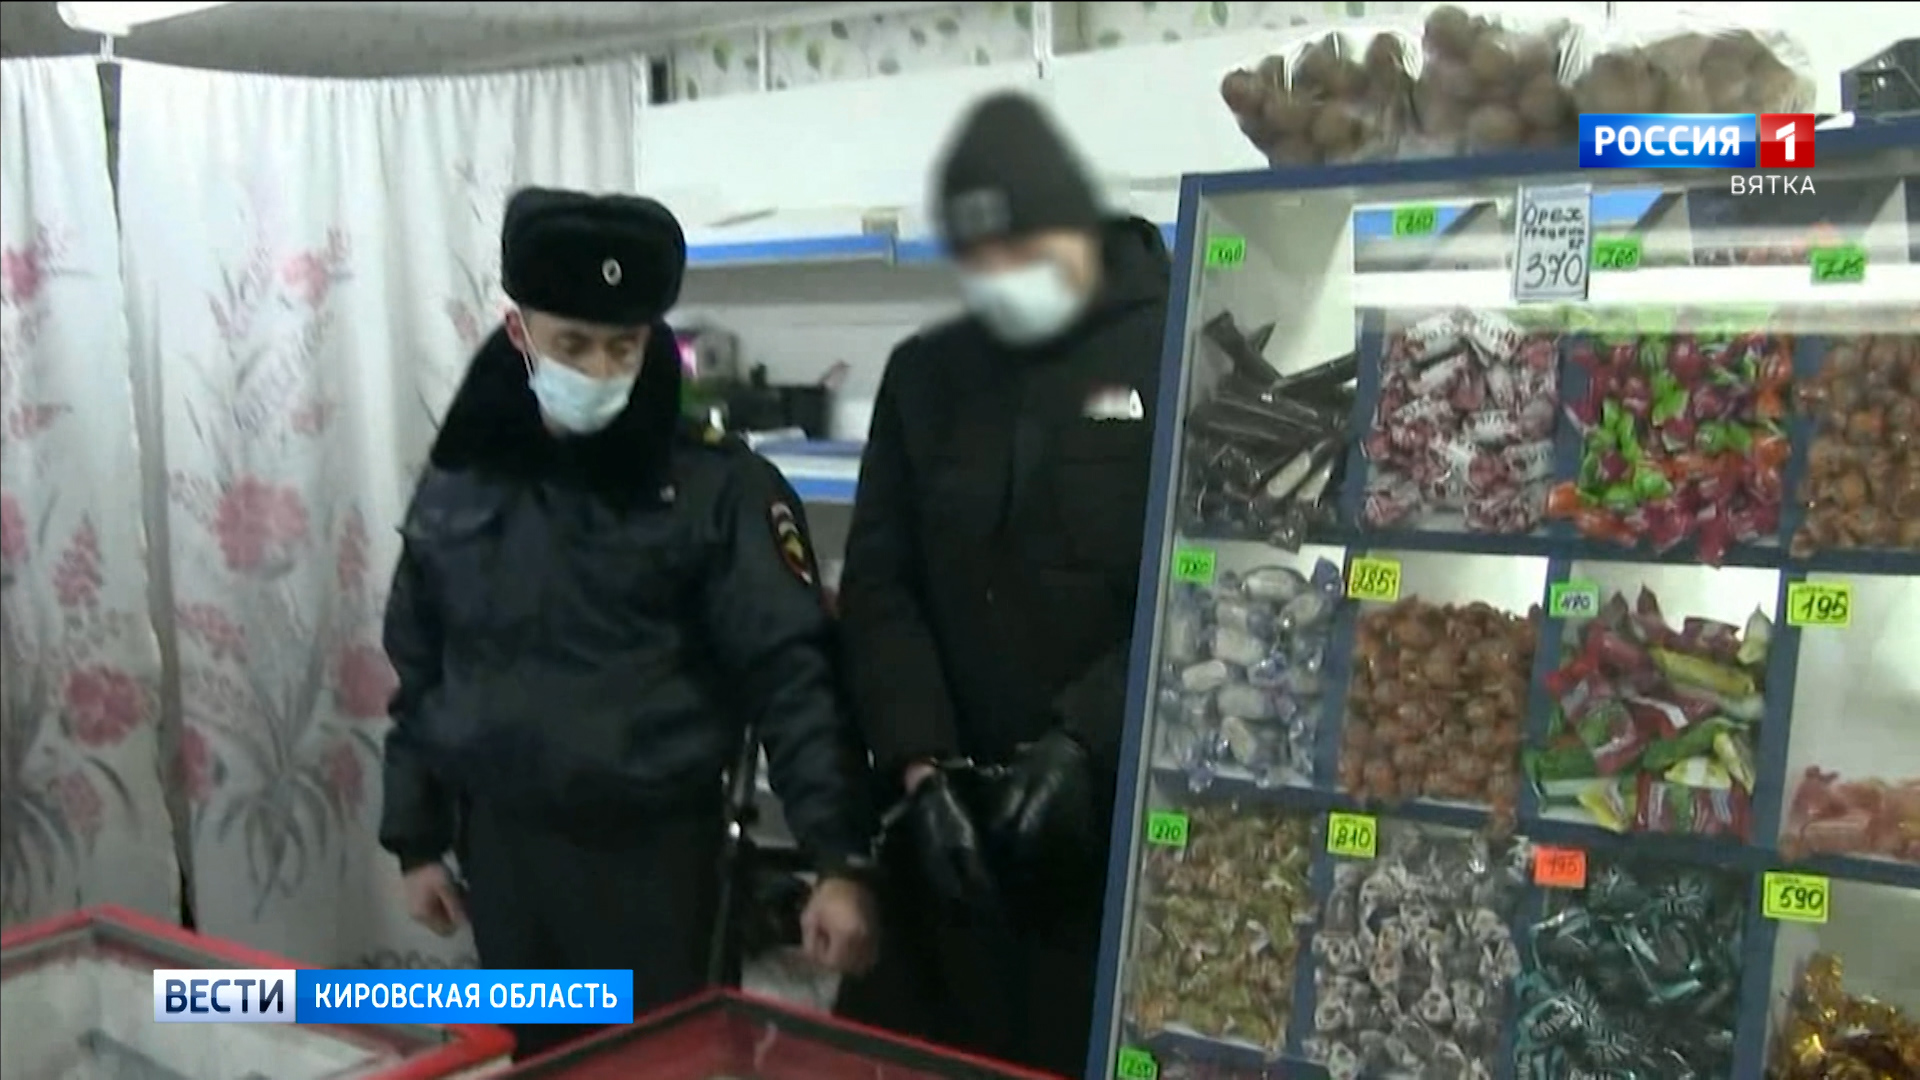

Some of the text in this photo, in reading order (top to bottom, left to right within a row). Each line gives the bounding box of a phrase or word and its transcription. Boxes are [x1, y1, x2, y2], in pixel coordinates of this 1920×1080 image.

[1523, 252, 1583, 289] 370
[1800, 591, 1847, 620] 195
[1779, 886, 1823, 910] 590
